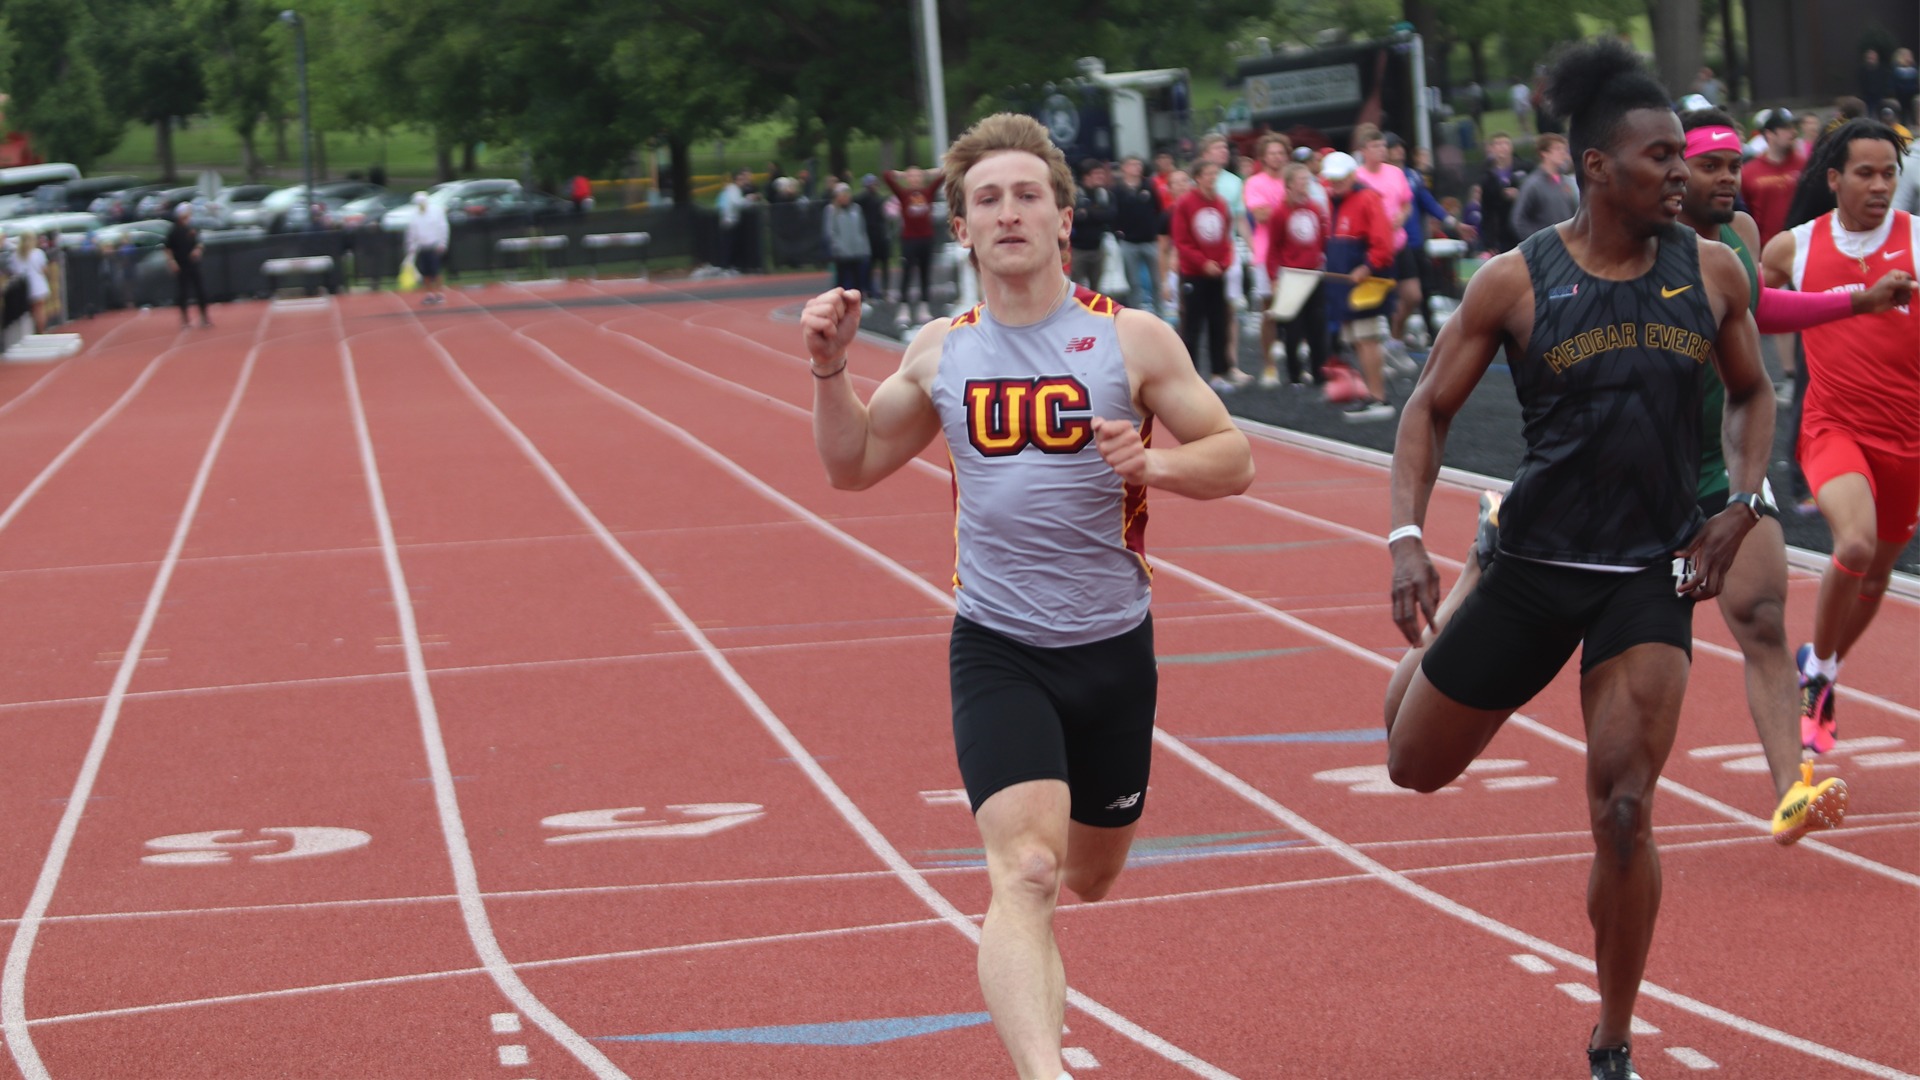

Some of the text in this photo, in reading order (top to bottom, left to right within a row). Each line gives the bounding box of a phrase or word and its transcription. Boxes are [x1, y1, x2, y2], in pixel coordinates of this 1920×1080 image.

[1543, 322, 1712, 375] MEDGAR EVERS
[963, 373, 1095, 458] UC
[539, 802, 766, 845] 5
